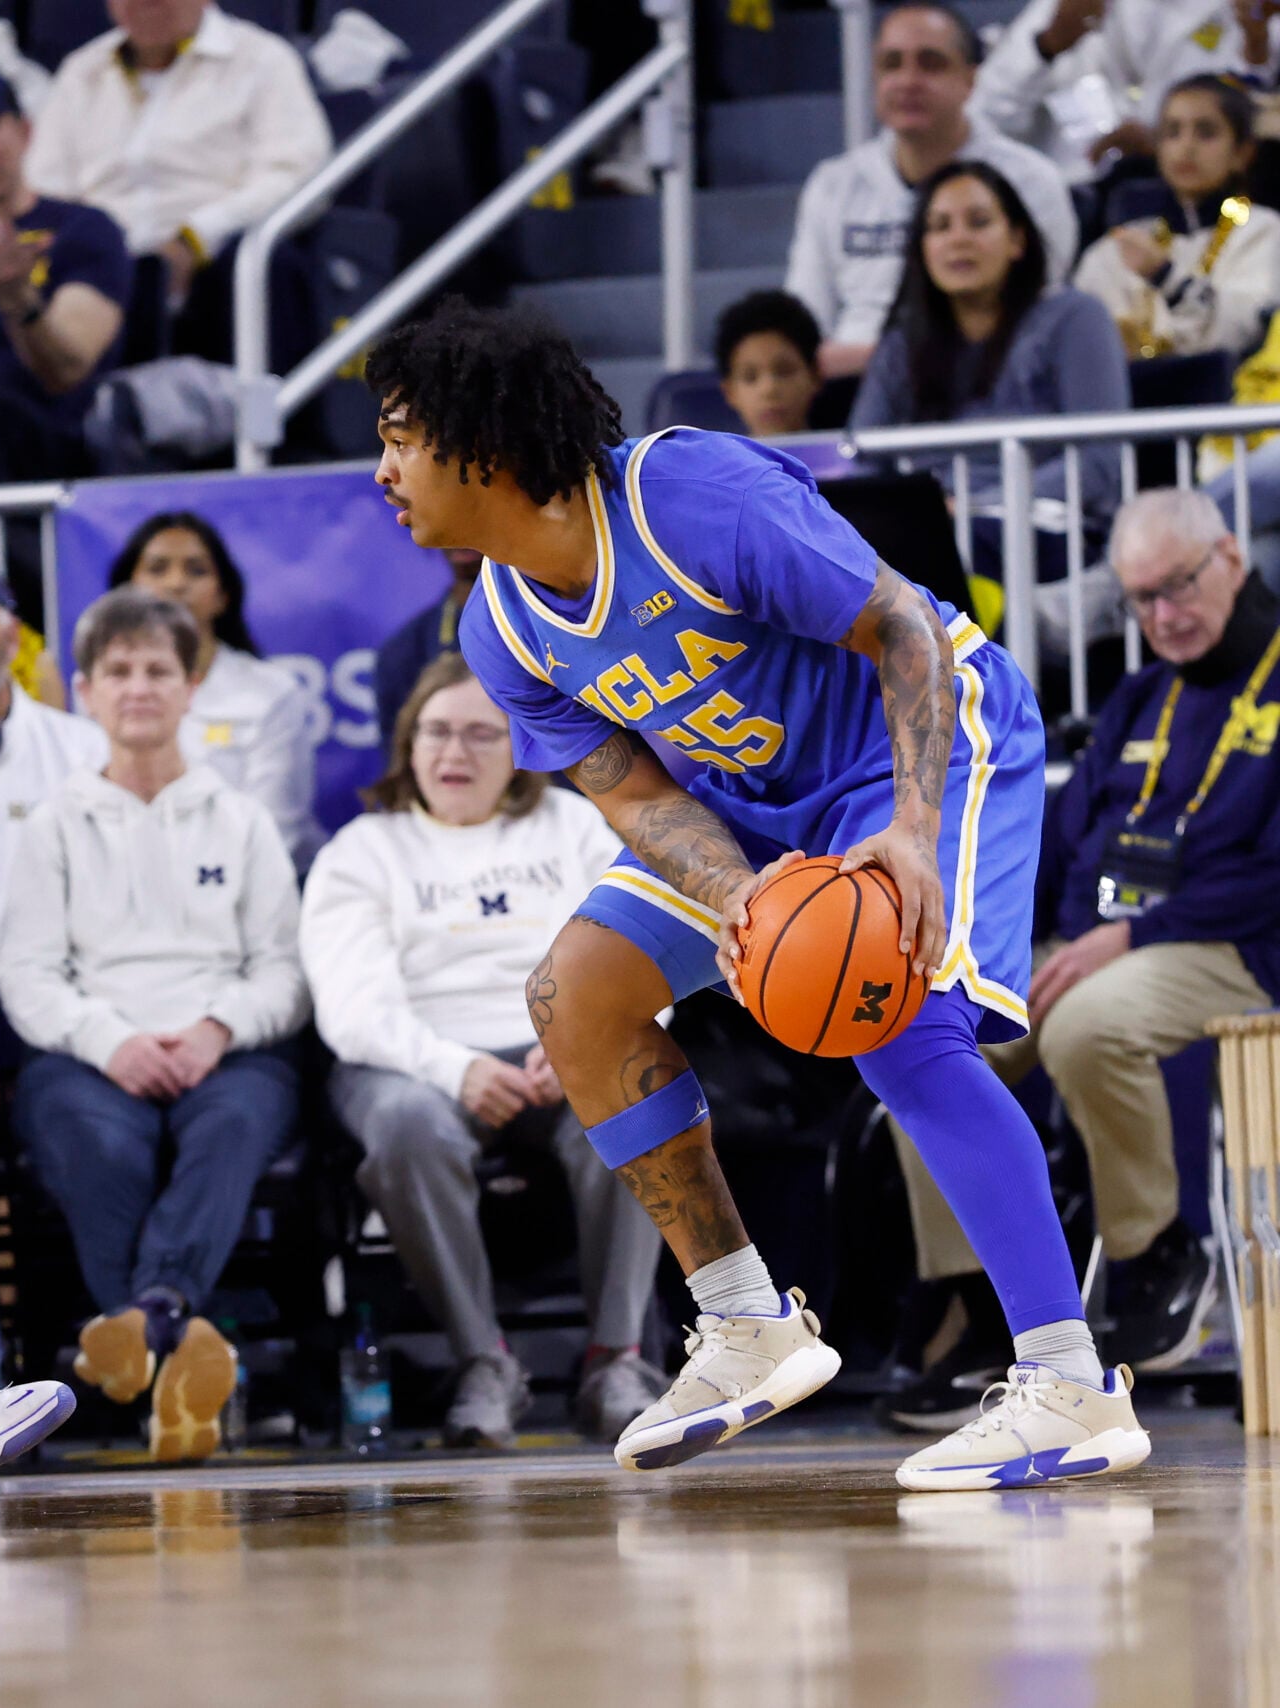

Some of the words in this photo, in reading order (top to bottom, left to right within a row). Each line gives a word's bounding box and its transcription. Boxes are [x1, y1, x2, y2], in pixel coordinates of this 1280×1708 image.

[197, 866, 226, 887] M
[478, 892, 510, 917] M
[850, 980, 894, 1024] M
